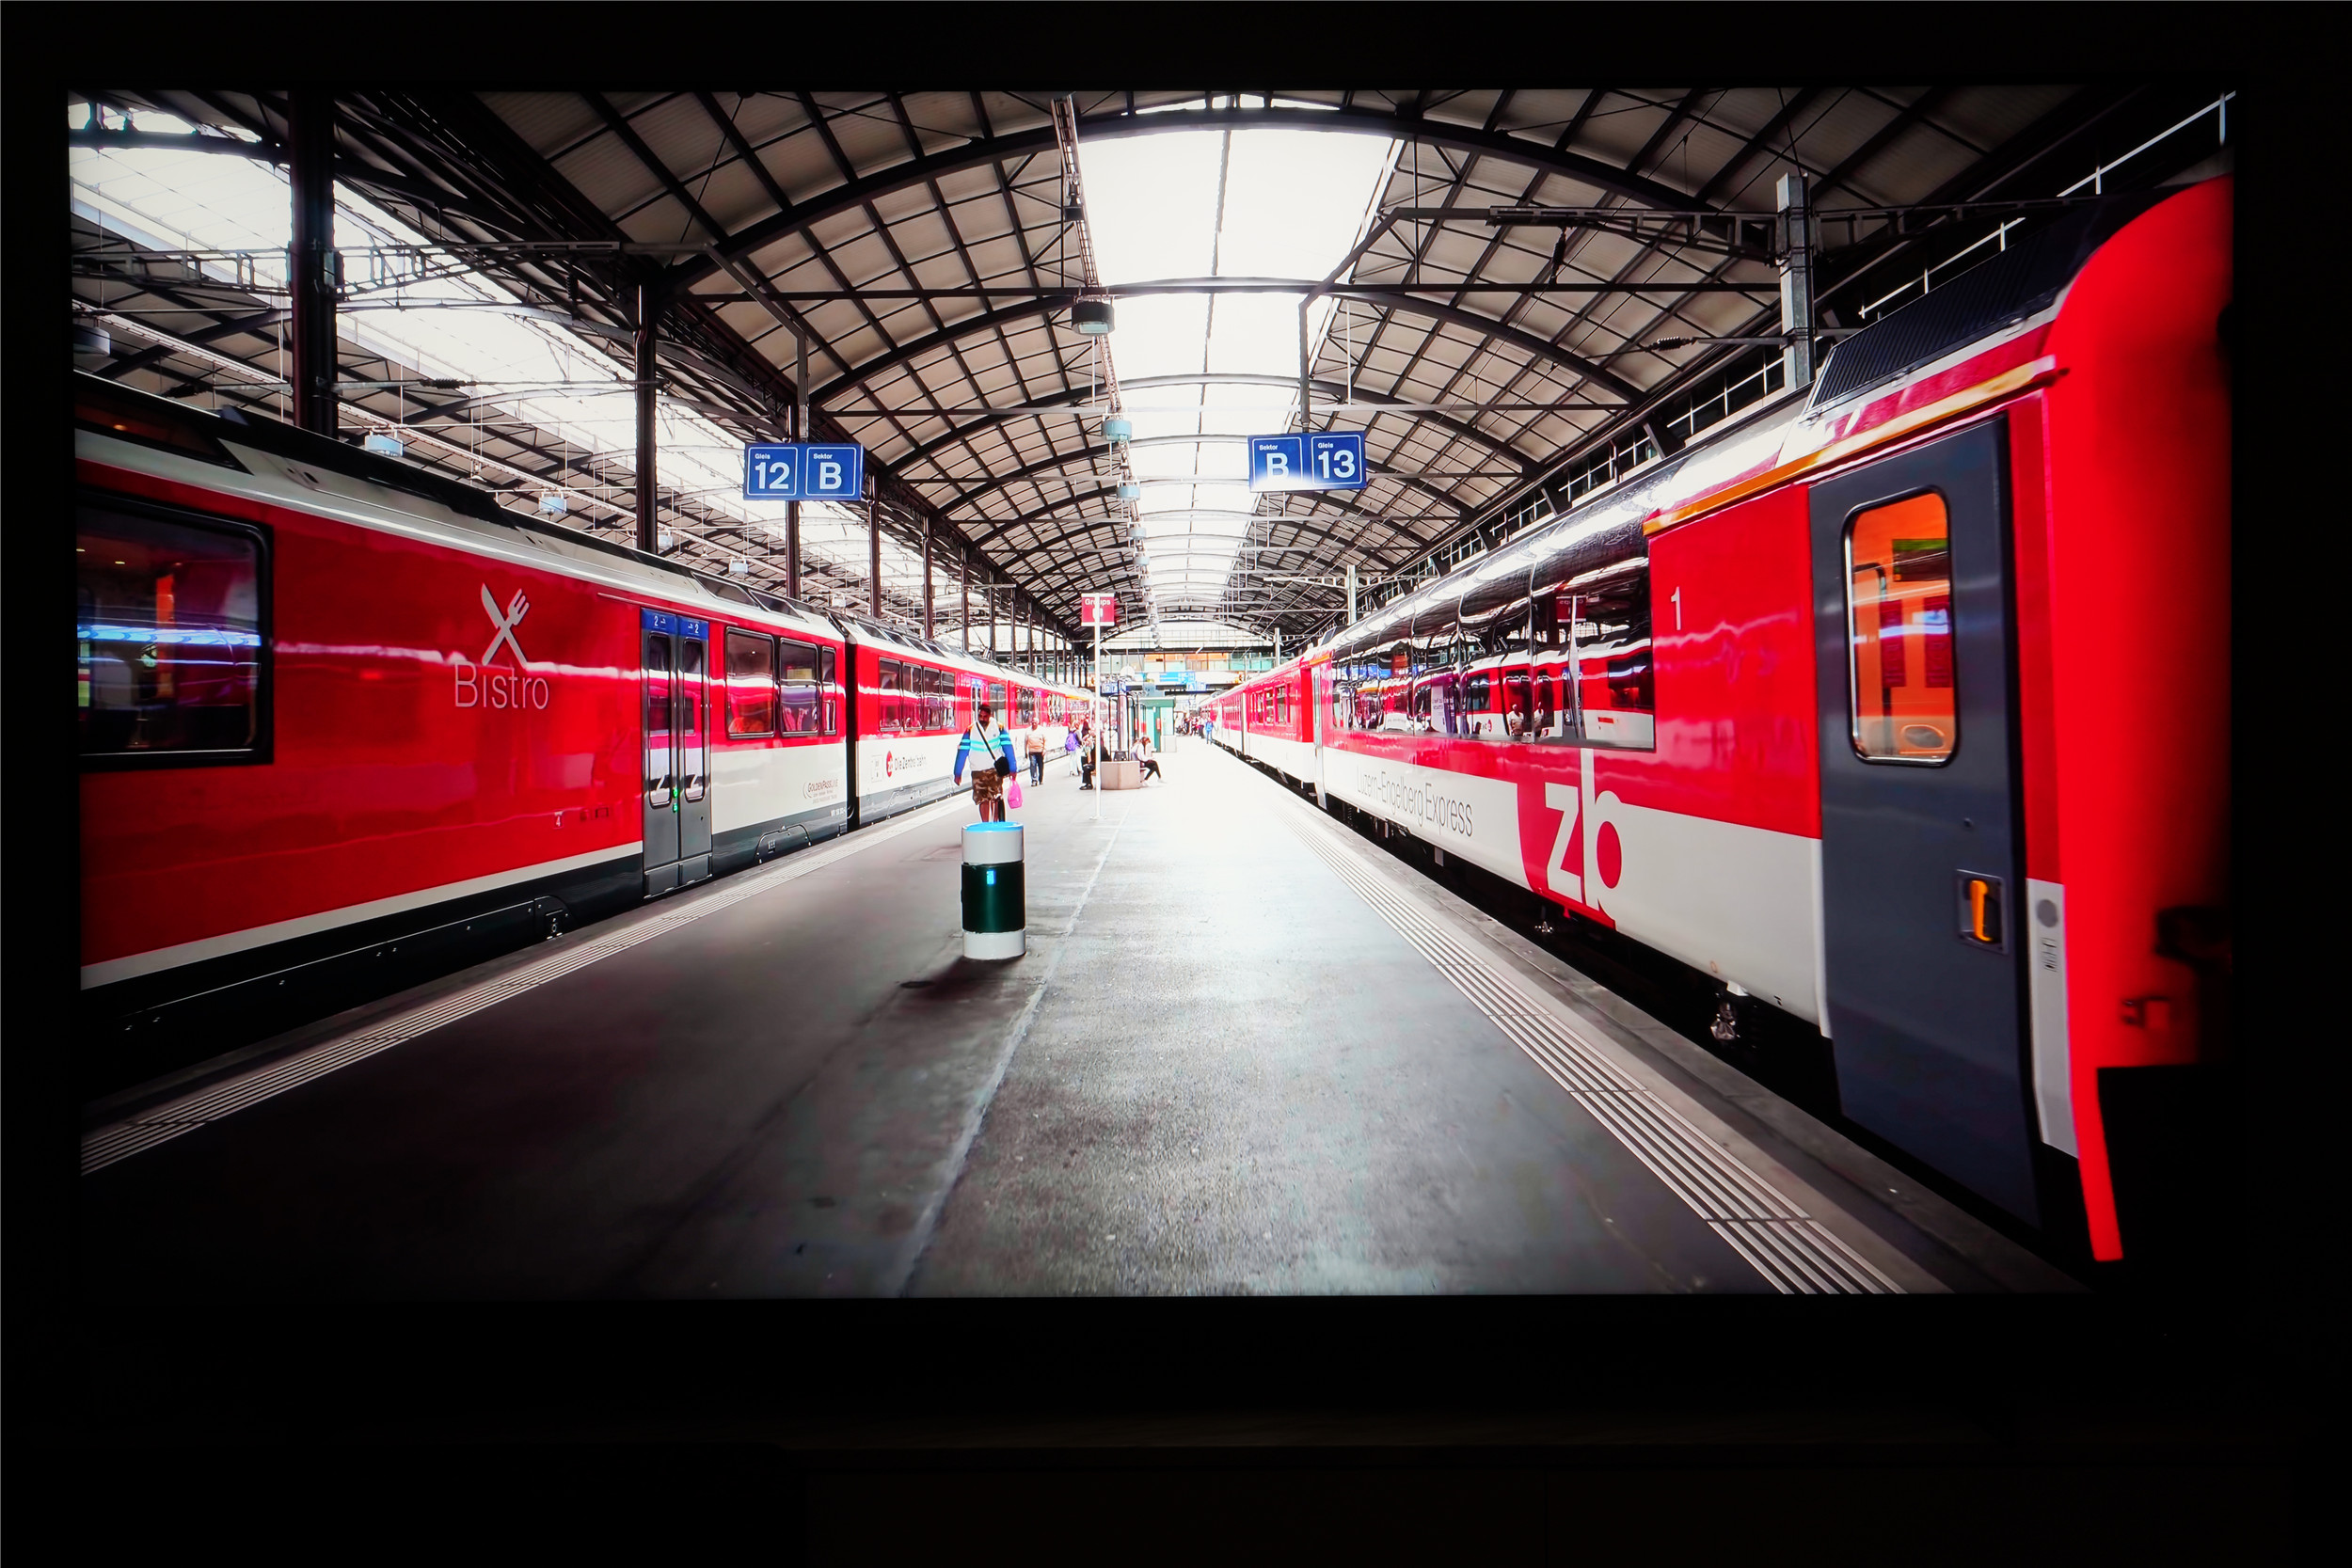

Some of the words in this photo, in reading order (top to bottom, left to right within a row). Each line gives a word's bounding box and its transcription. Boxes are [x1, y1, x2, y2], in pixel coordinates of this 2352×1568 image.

[755, 461, 790, 490] 12
[818, 461, 842, 490] B
[1266, 452, 1290, 480] B
[1317, 450, 1356, 479] 13
[654, 615, 659, 626] 2
[1671, 586, 1681, 630] 1
[694, 623, 699, 634] 2
[454, 661, 549, 709] Bistro
[1424, 782, 1473, 837] Express
[1544, 747, 1625, 912] zb
